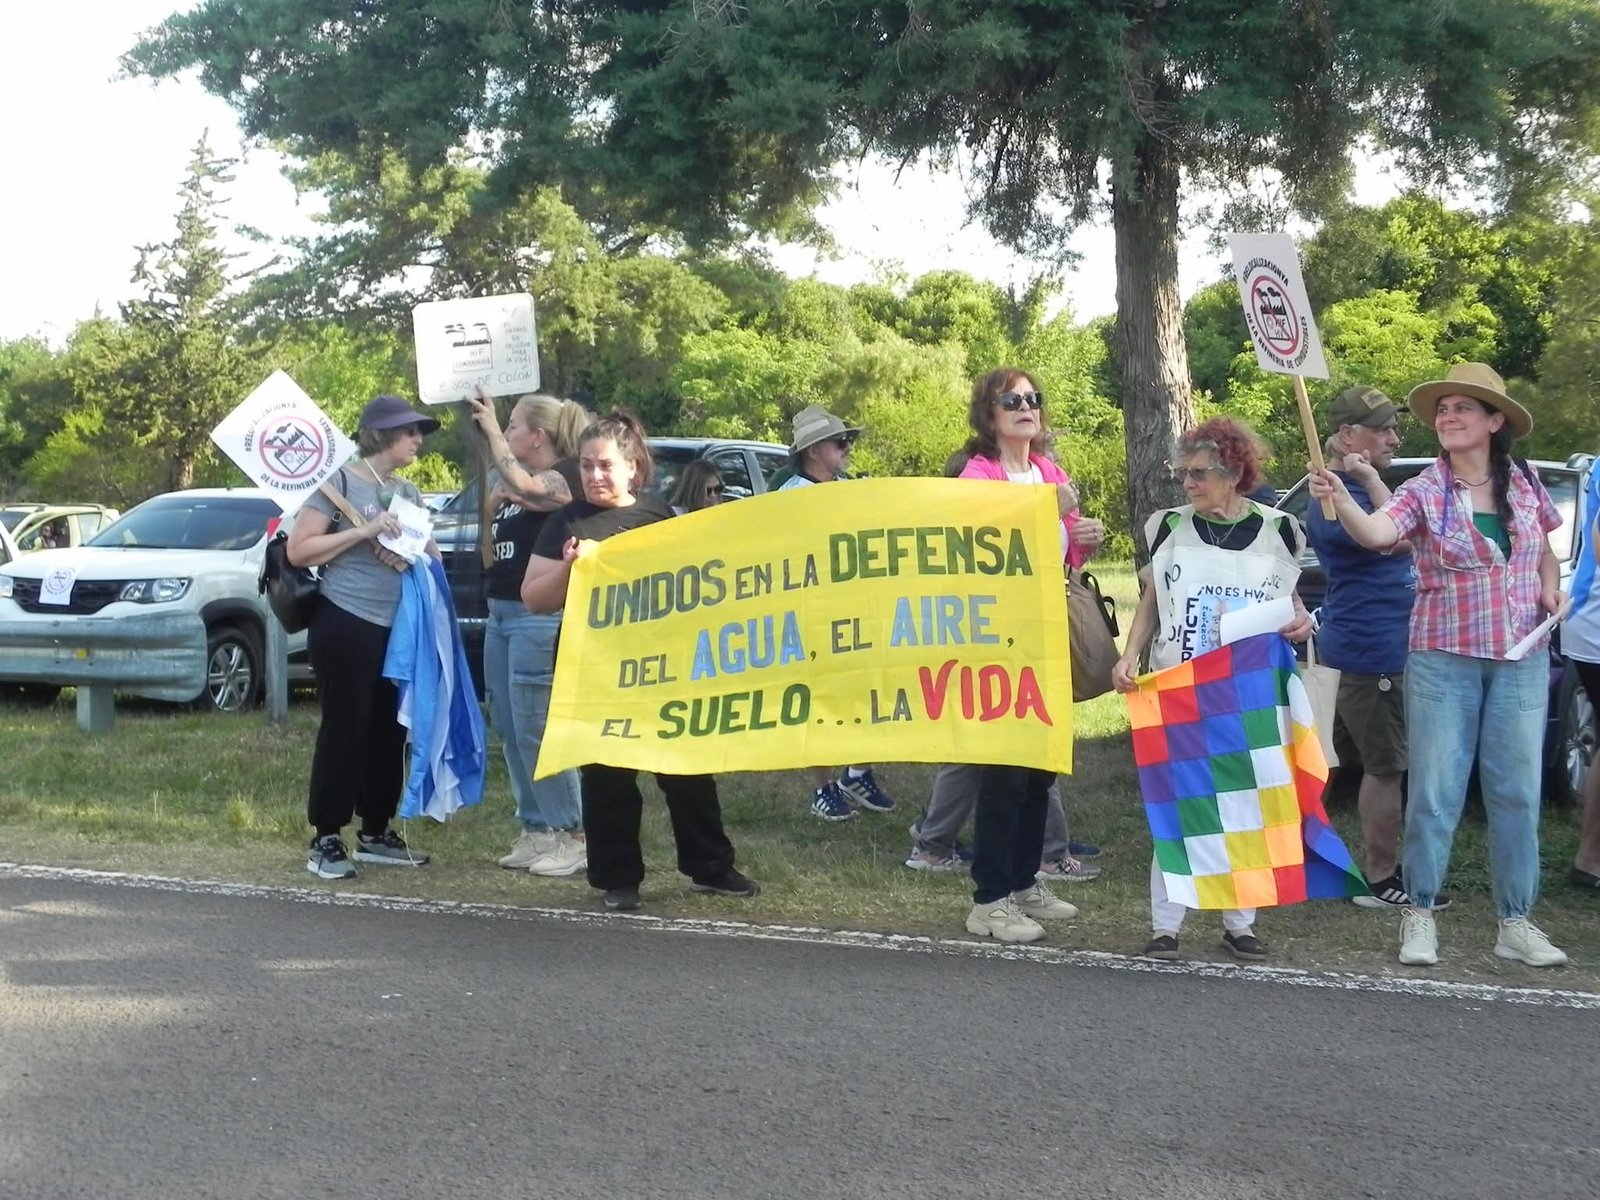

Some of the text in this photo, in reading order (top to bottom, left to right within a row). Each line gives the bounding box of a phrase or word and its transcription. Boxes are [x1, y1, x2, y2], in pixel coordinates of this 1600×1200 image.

[1246, 313, 1252, 325] DE
[1252, 326, 1258, 337] LA
[1287, 359, 1294, 369] DE
[477, 374, 492, 386] DE
[260, 472, 270, 483] DE
[270, 479, 279, 489] LA
[281, 477, 318, 492] REFINERIA
[318, 468, 328, 480] DE
[587, 525, 1034, 629] UNIDOS EN LA DEFENSA
[1225, 587, 1240, 597] ES
[1244, 588, 1265, 603] HV!
[618, 594, 1014, 688] DEL AGUA, EL AIRE,
[600, 718, 641, 739] EL
[870, 688, 913, 725] LA
[918, 659, 1054, 727] VIDA
